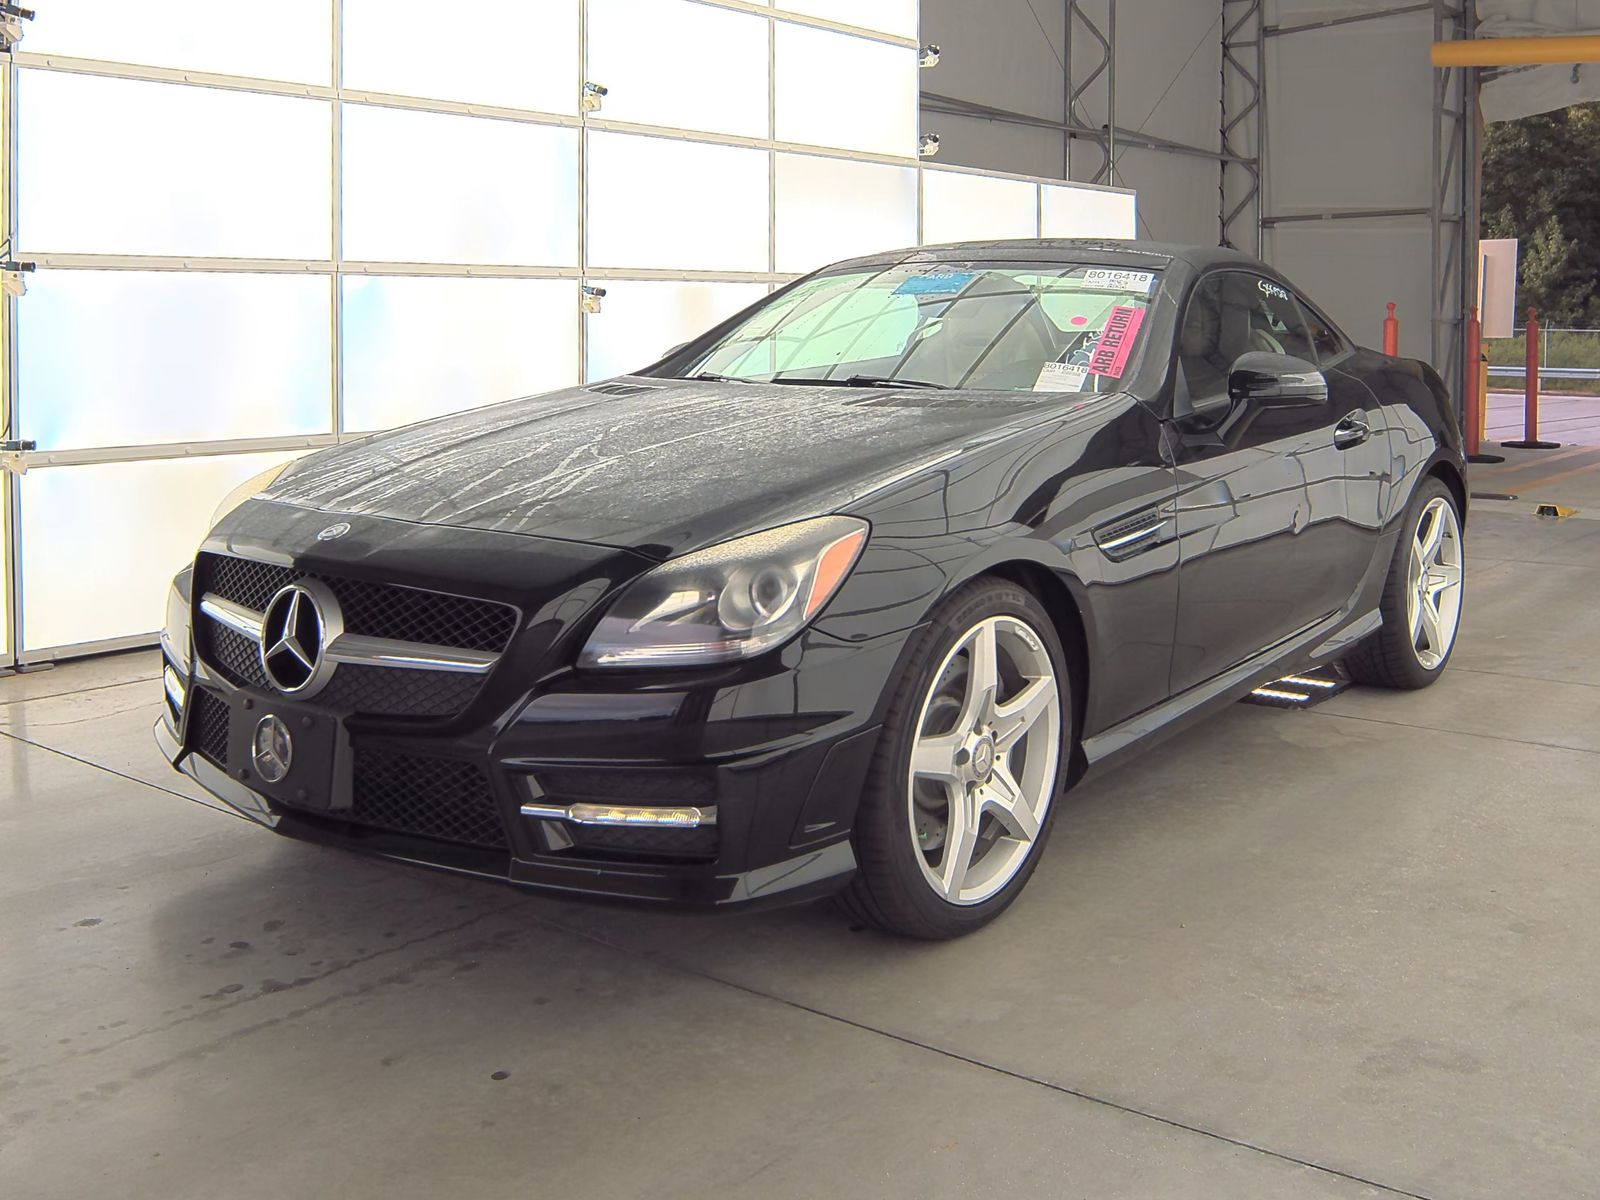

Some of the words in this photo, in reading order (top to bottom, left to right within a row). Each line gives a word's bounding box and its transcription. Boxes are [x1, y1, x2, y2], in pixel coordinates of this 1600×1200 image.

[1088, 270, 1148, 282] 8016418
[1101, 308, 1133, 348] RETURN
[1092, 350, 1116, 374] ARB
